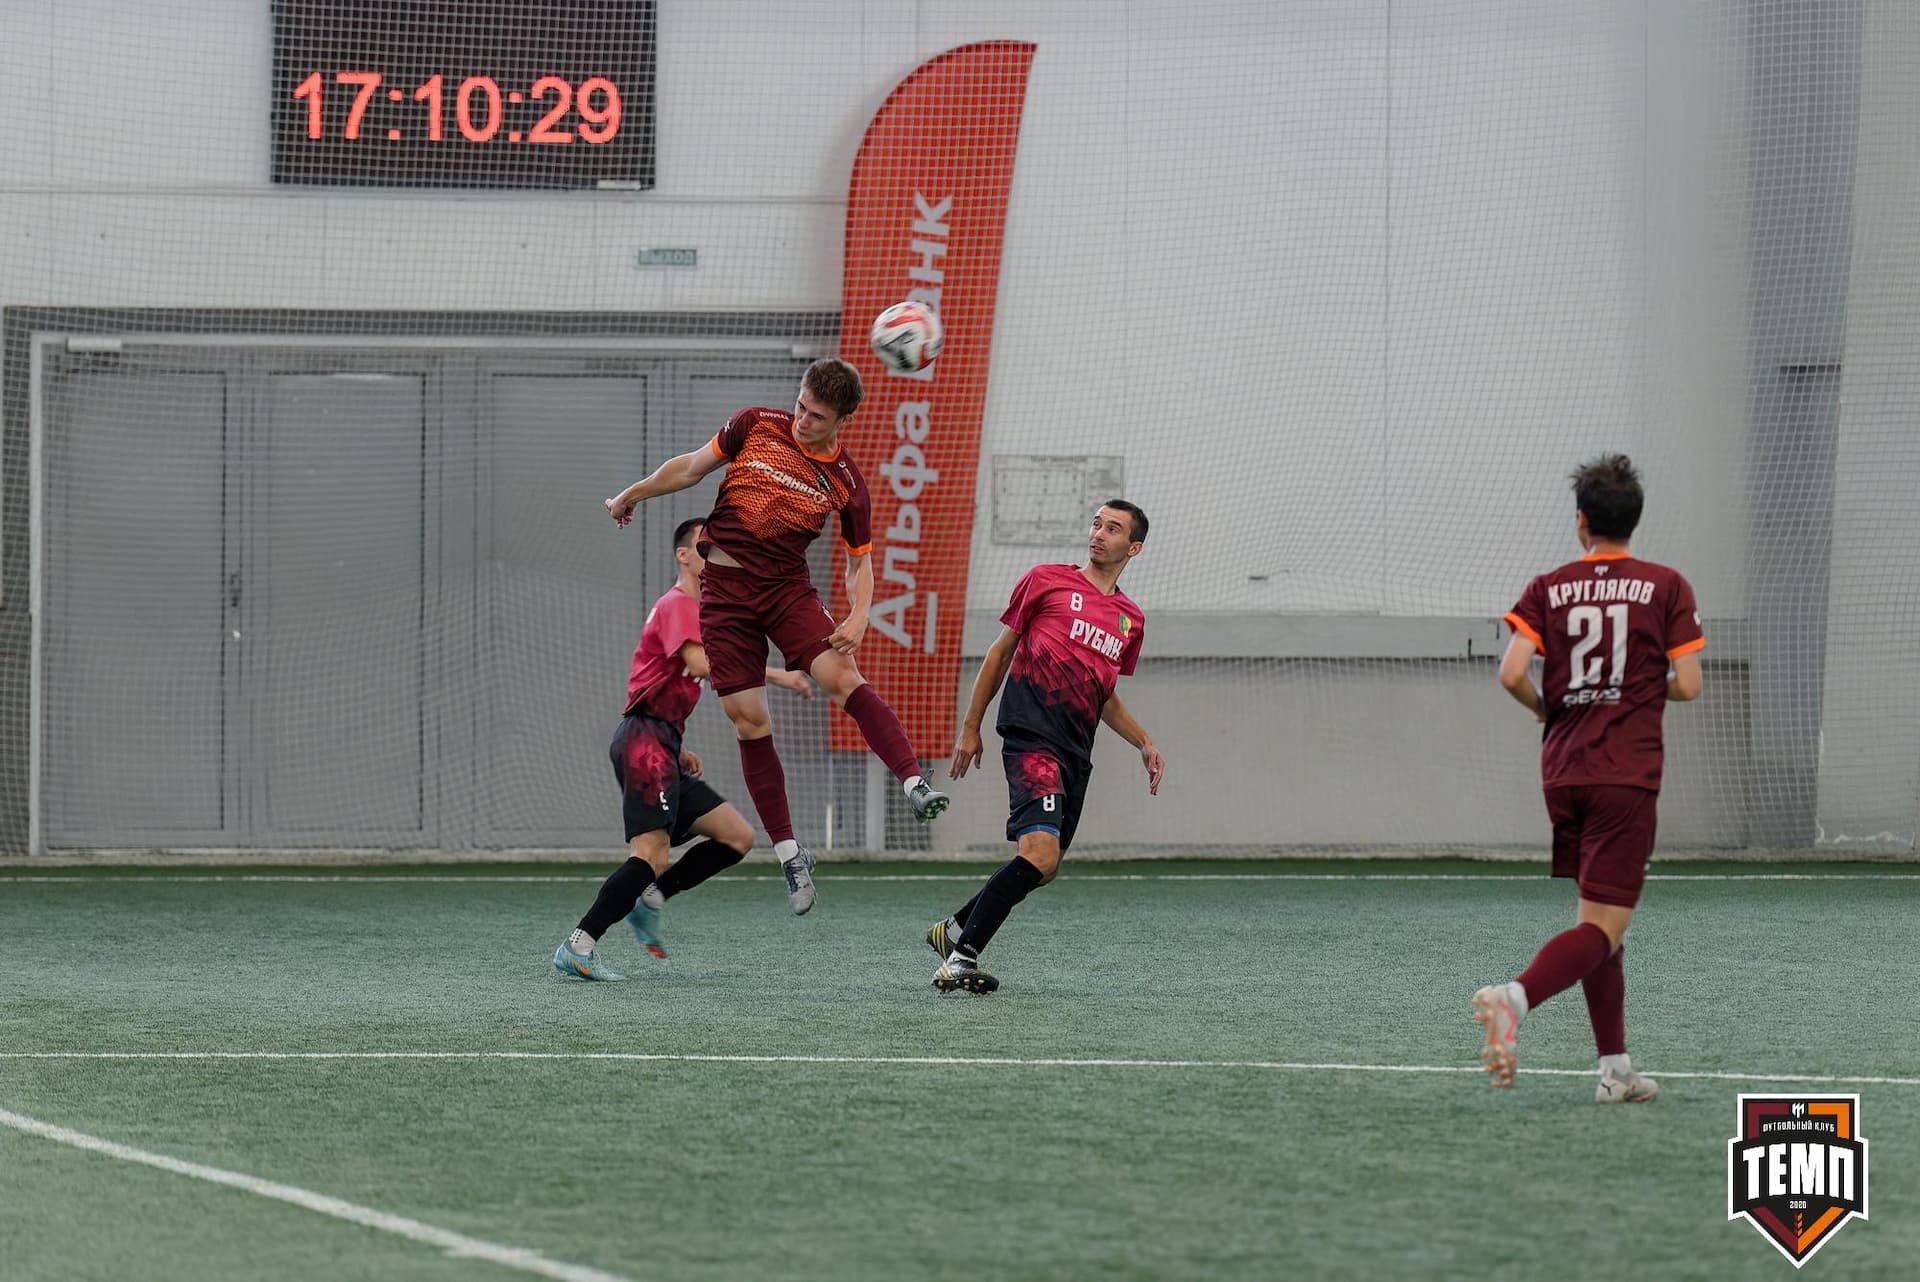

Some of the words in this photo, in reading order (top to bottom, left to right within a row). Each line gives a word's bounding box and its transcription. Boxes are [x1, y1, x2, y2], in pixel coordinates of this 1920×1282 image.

[293, 71, 623, 145] 17:10:29
[869, 400, 940, 649] Альфа
[1070, 591, 1084, 612] 8
[1547, 578, 1656, 609] КРУГЛЯКОВ
[1567, 603, 1630, 690] 21
[1042, 794, 1056, 812] 8
